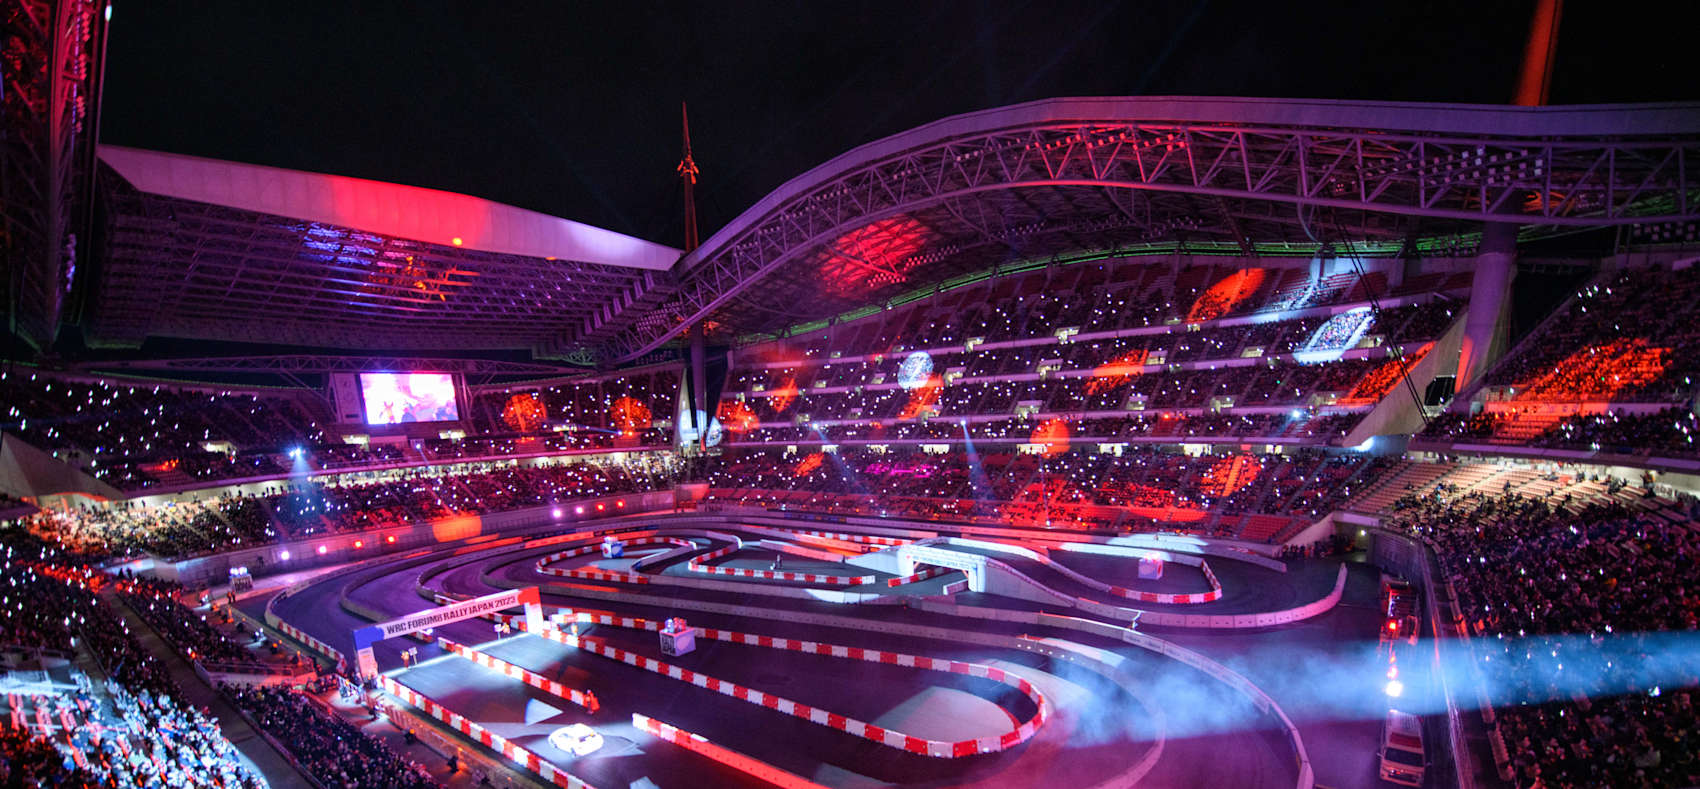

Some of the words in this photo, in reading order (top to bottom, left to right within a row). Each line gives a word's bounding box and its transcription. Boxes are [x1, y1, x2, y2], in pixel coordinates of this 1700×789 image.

[386, 622, 406, 634] WRC
[408, 615, 443, 630] FORUM8
[443, 608, 468, 620] RALLY
[468, 602, 494, 615] JAPAN
[494, 595, 515, 608] 2023
